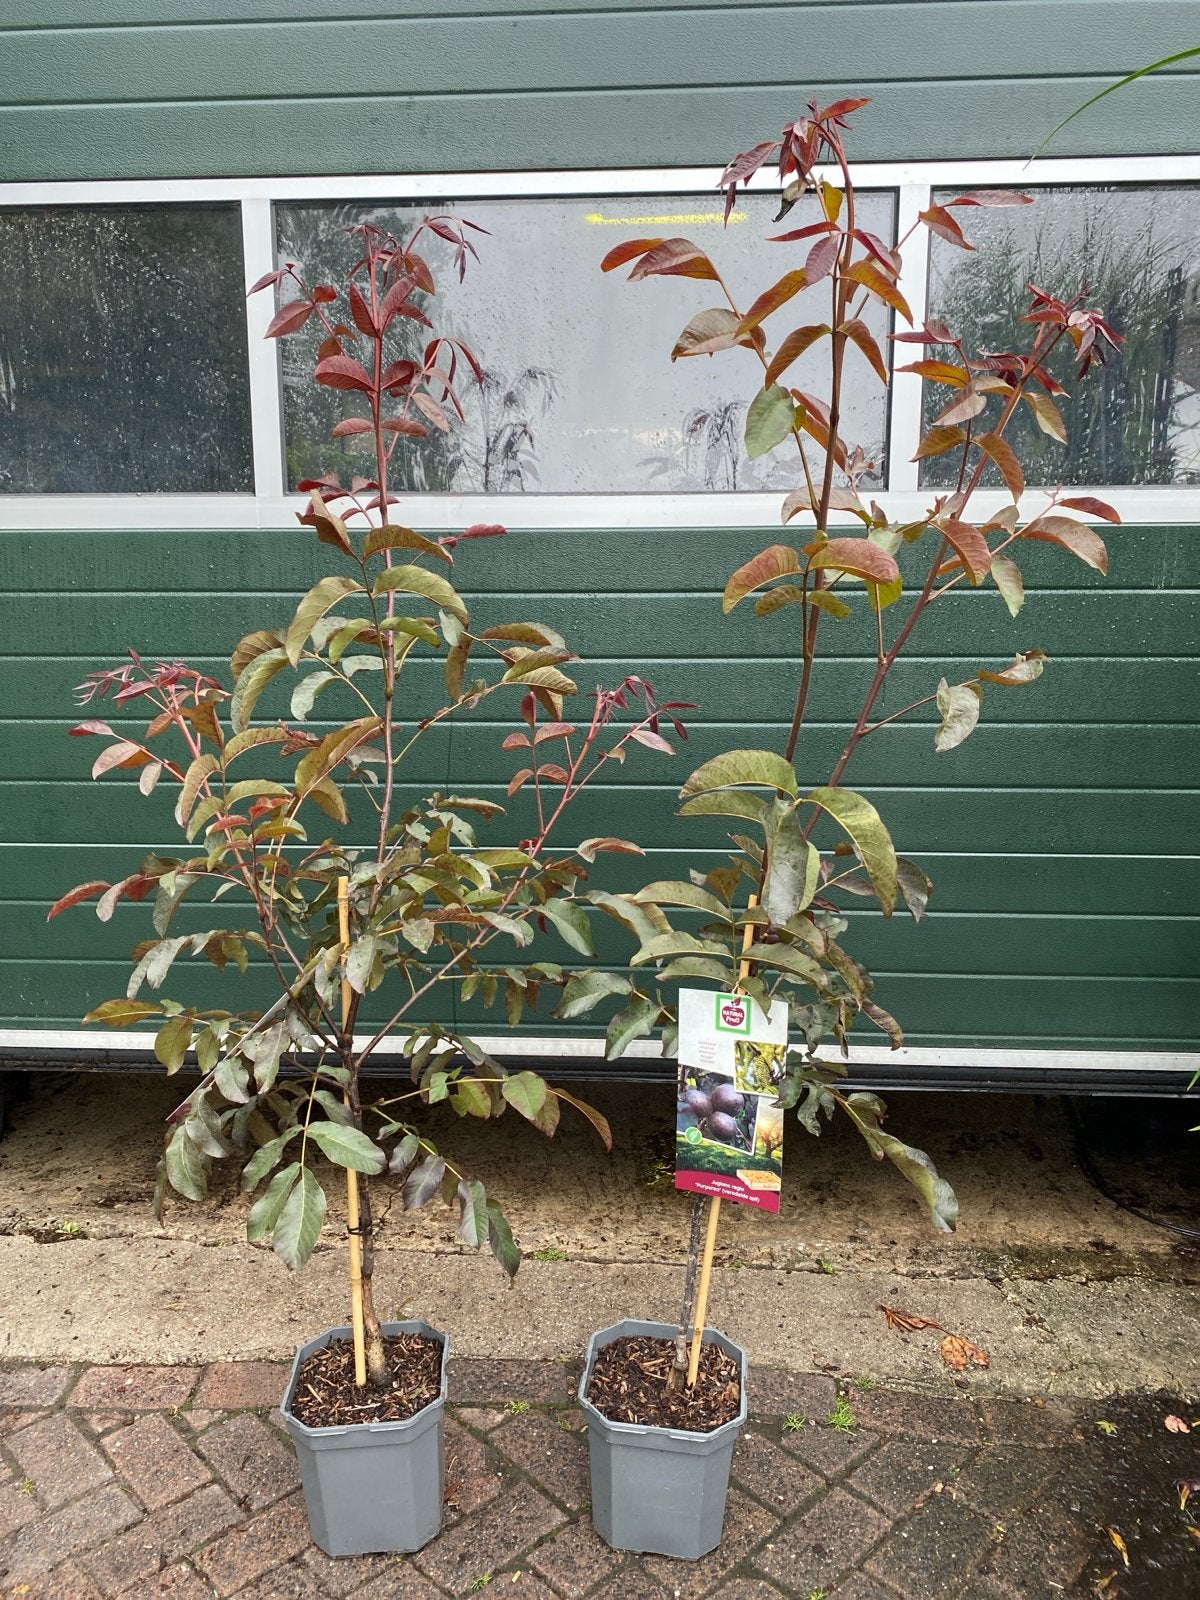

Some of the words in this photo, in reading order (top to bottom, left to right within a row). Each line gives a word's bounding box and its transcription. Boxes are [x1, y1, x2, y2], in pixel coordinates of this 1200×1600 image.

[722, 1010, 744, 1018] NATURAL
[711, 1179, 731, 1189] Juglans
[731, 1184, 745, 1192] regia
